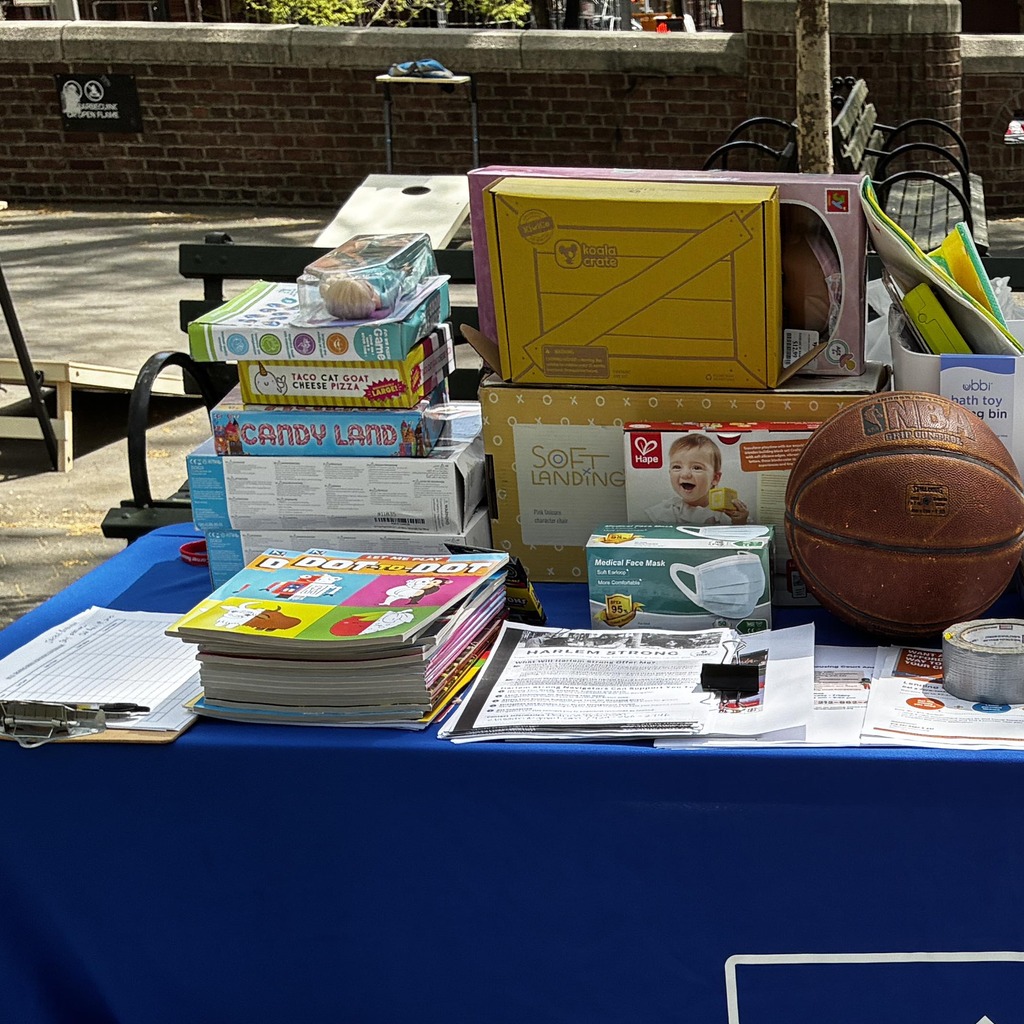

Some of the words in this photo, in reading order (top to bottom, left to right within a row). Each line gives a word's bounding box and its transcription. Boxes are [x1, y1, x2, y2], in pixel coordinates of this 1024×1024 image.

[582, 244, 617, 256] koala
[583, 257, 617, 267] crate
[373, 328, 386, 361] Game
[321, 374, 338, 382] CAT
[343, 375, 369, 383] GOAT
[292, 382, 327, 390] CHEESE
[331, 383, 360, 391] PIZZA
[372, 385, 398, 397] LARGE!
[963, 380, 991, 392] ubbi
[951, 394, 981, 406] bath
[983, 396, 1003, 409] toy
[988, 408, 1007, 419] bin
[885, 400, 977, 442] NBA
[240, 423, 327, 446] CANDY
[334, 424, 397, 446] LAND
[885, 431, 912, 440] GRIP
[914, 431, 963, 445] CONTROL
[531, 445, 610, 470] SOFT
[635, 454, 659, 465] Hape
[594, 559, 624, 567] Medical
[625, 559, 644, 567] Face
[645, 559, 666, 567] Mask
[904, 661, 931, 669] YOUR
